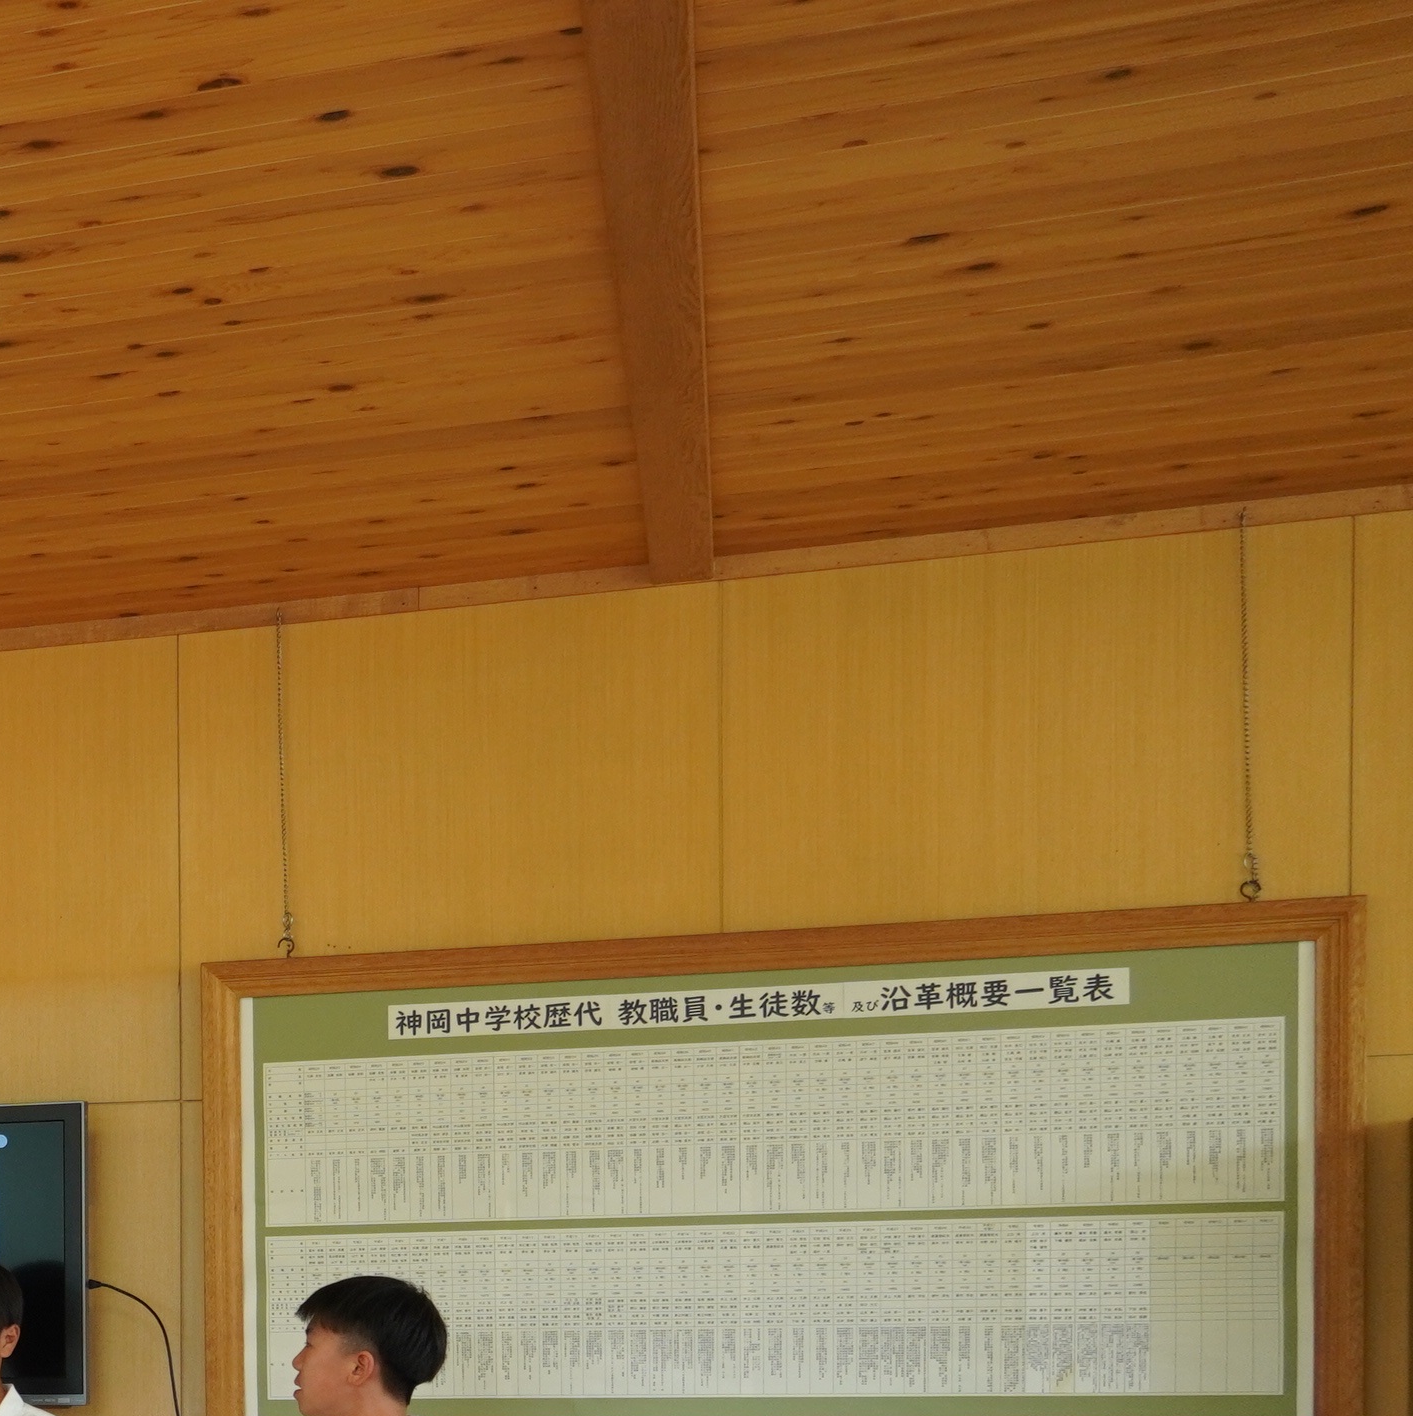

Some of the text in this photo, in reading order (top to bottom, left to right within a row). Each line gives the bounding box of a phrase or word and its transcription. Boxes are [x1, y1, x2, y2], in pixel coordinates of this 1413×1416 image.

[395, 973, 1115, 1036] 神岡中学校歴代 教職員・生徒数等 及び沿革概要一覧表
